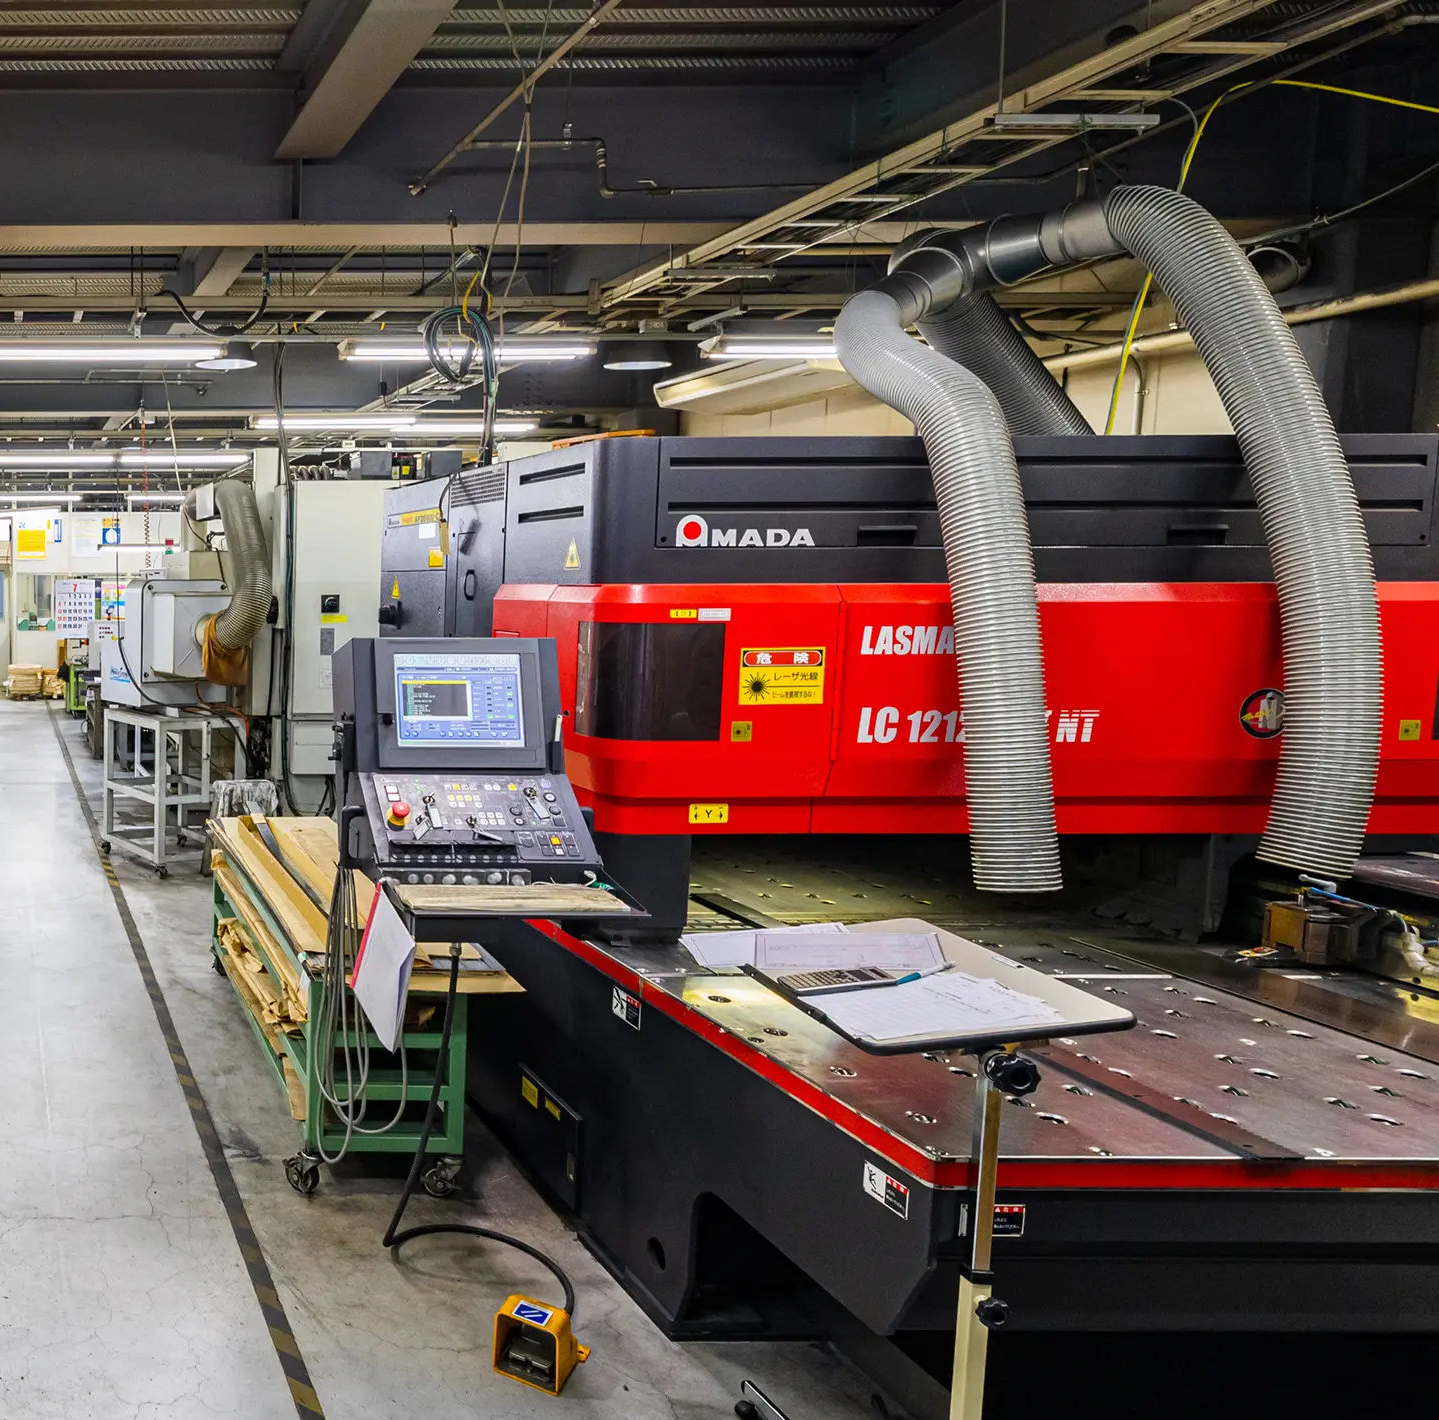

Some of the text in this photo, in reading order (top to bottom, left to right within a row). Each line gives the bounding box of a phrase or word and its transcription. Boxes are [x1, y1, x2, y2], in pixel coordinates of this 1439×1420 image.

[675, 514, 816, 548] AMADA
[72, 584, 78, 592] 7
[860, 626, 957, 655] LASMA
[756, 653, 809, 664] 危険
[774, 671, 819, 682] レーザ光線
[857, 706, 899, 744] LC
[1055, 710, 1101, 743] NT
[705, 809, 713, 818] Y
